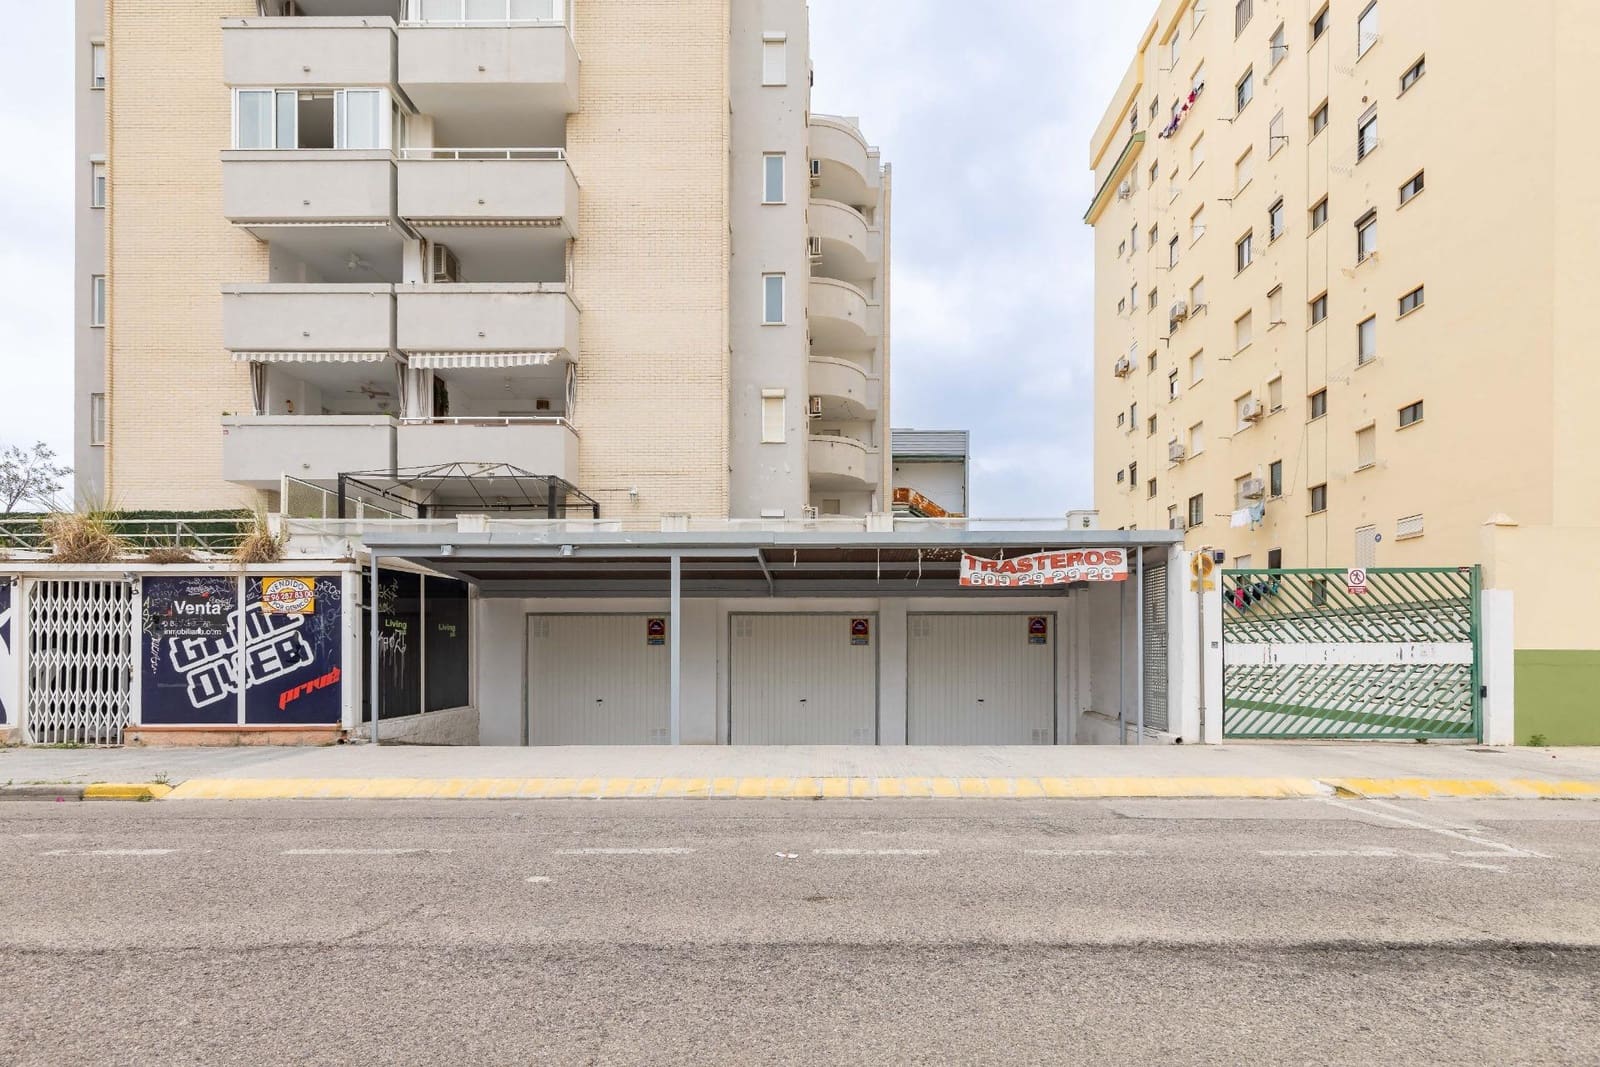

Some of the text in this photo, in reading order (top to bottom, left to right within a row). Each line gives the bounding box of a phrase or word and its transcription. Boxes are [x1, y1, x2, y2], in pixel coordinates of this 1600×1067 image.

[964, 550, 1123, 574] TRASTEROS
[1018, 572, 1045, 586] 29
[1052, 569, 1081, 584] 29
[1086, 566, 1114, 581] 28
[270, 579, 304, 593] VENDIDO
[173, 600, 221, 615] Venta
[385, 619, 408, 630] Living
